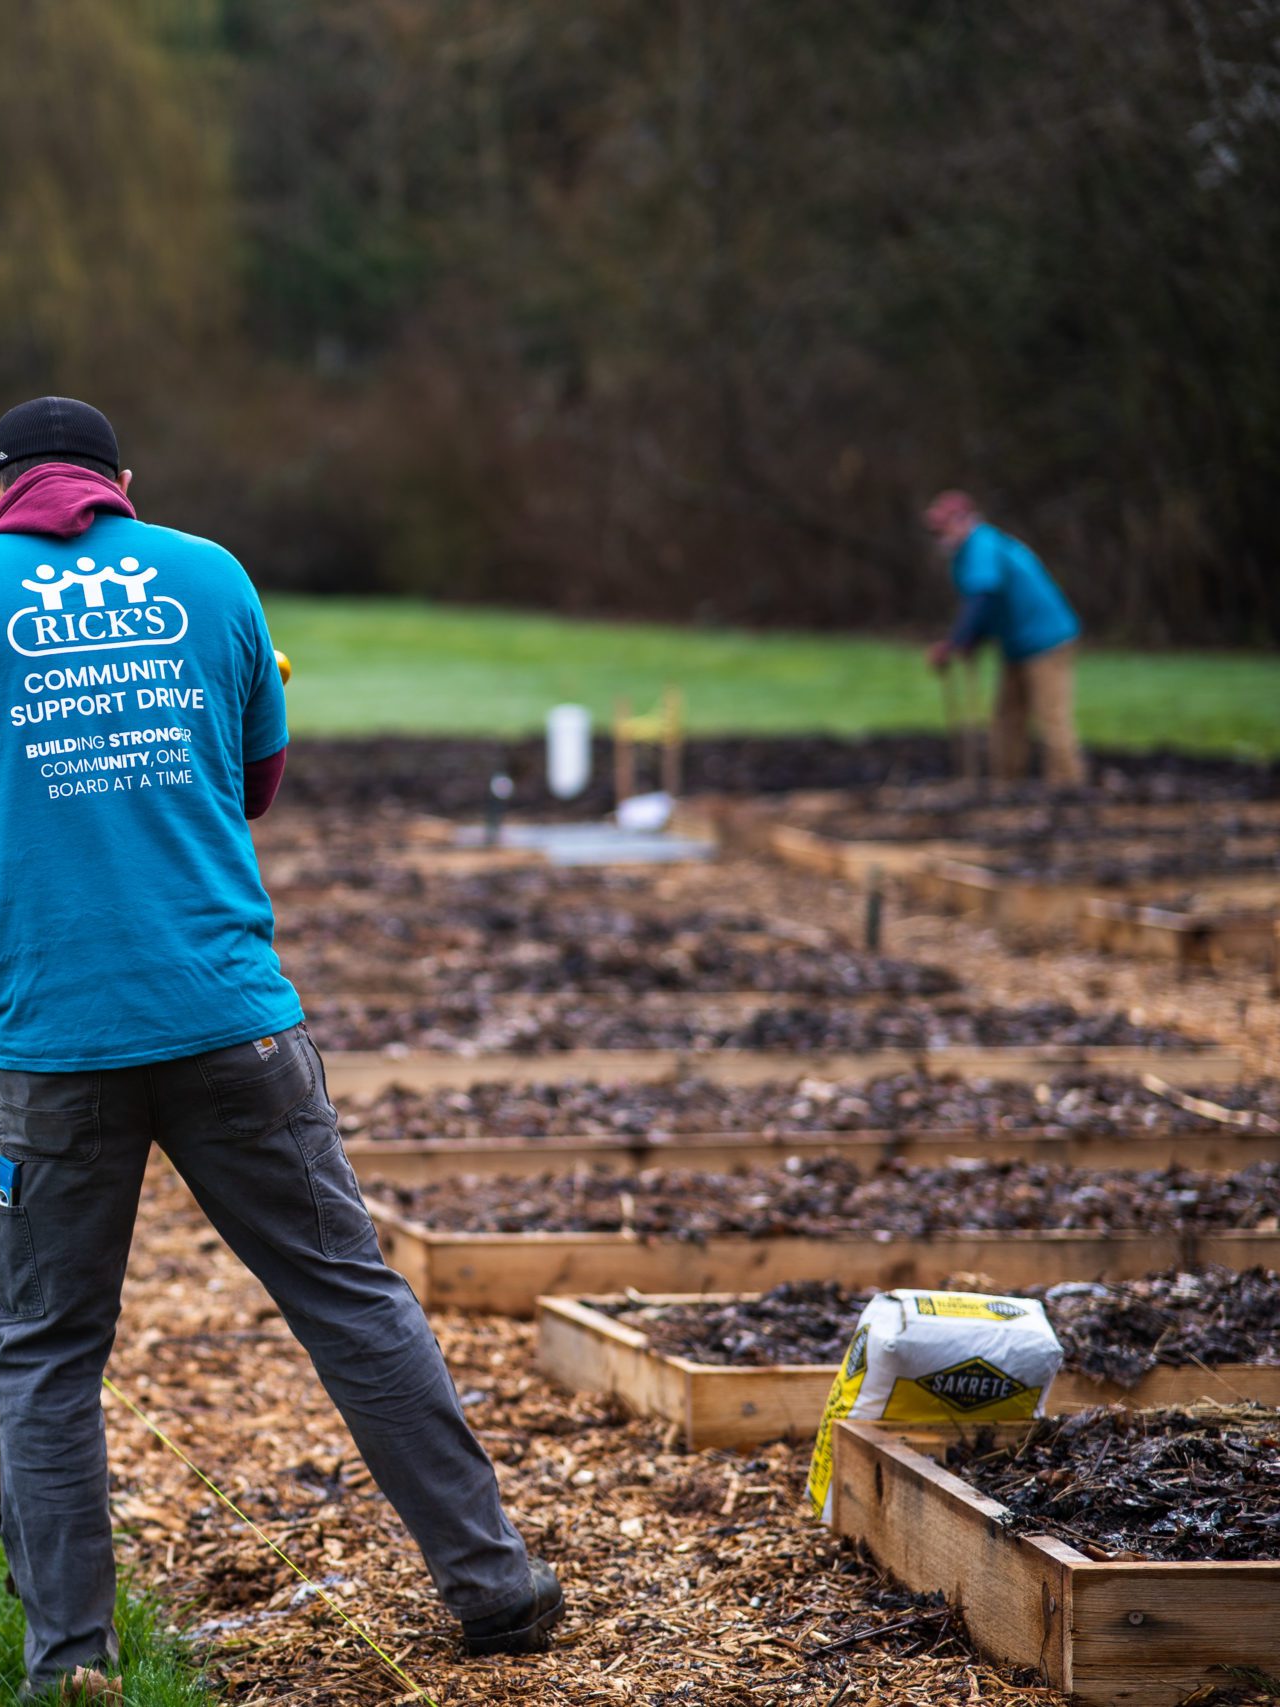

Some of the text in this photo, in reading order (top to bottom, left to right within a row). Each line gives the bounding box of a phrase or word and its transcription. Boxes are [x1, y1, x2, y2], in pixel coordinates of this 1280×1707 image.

[32, 606, 165, 645] RICK'S
[24, 659, 184, 693] COMMUNITY
[10, 687, 204, 727] SUPPORT DRIVE
[26, 727, 192, 759] BUILDING STRONGER
[41, 748, 190, 778] COMMUNITY, ONE
[48, 769, 193, 799] BOARD AT A TIME
[932, 1374, 1011, 1398] SAKRETE
